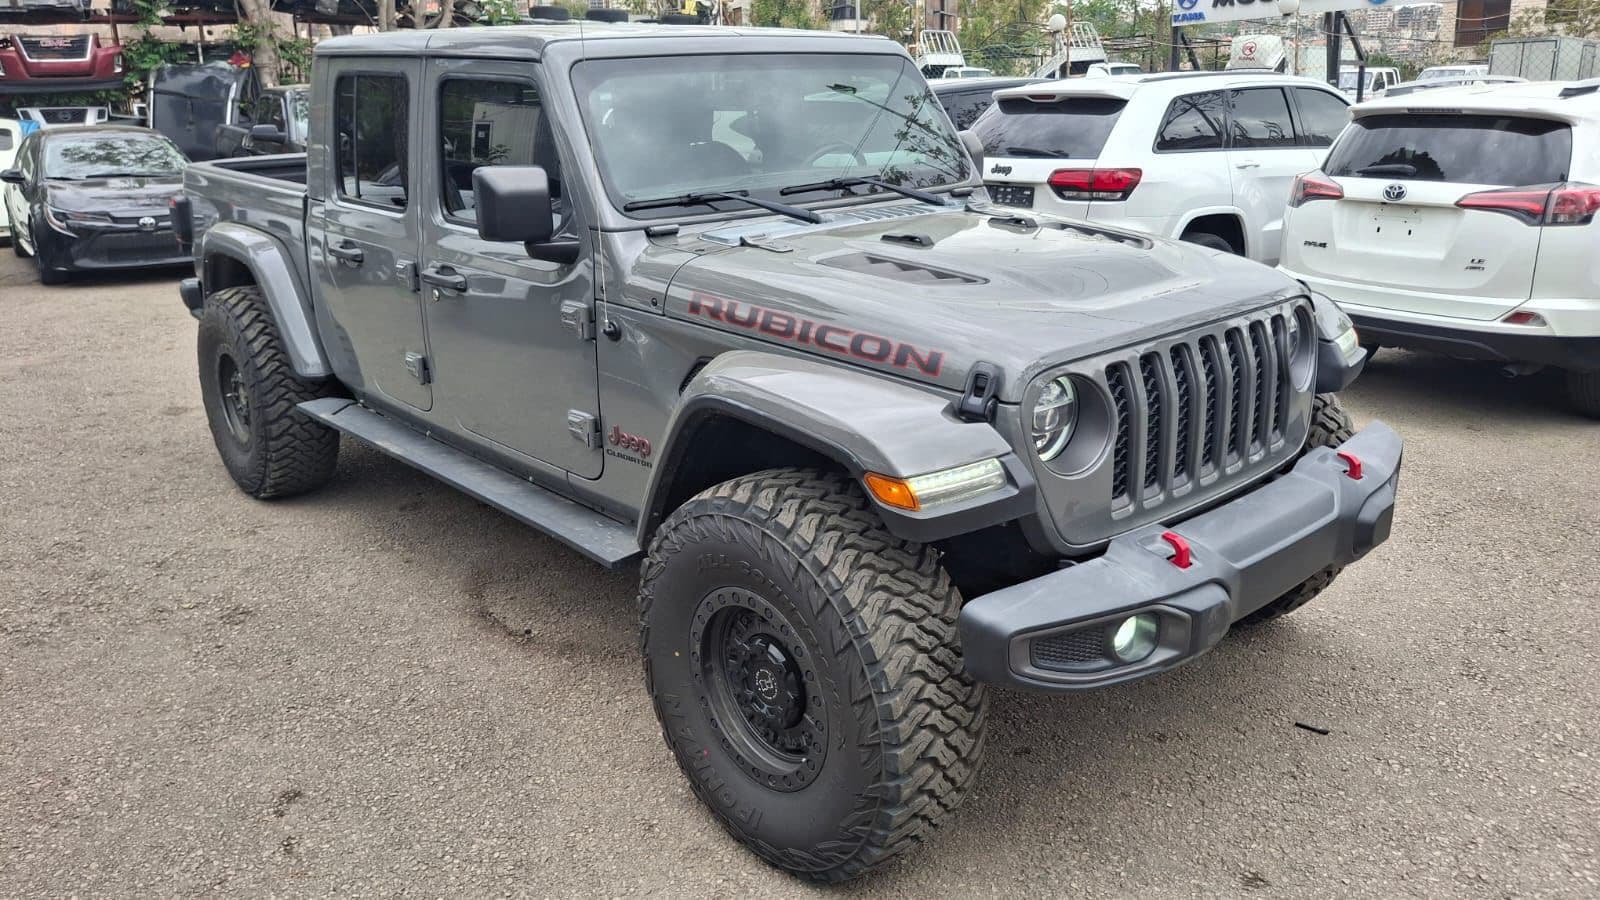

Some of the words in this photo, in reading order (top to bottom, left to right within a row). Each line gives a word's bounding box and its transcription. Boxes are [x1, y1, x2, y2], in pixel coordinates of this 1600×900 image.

[1172, 11, 1206, 23] KAMA
[991, 163, 1013, 177] Jeep
[688, 290, 946, 377] RUBICON
[608, 423, 652, 460] Jeep
[606, 448, 653, 469] GLADIATOR
